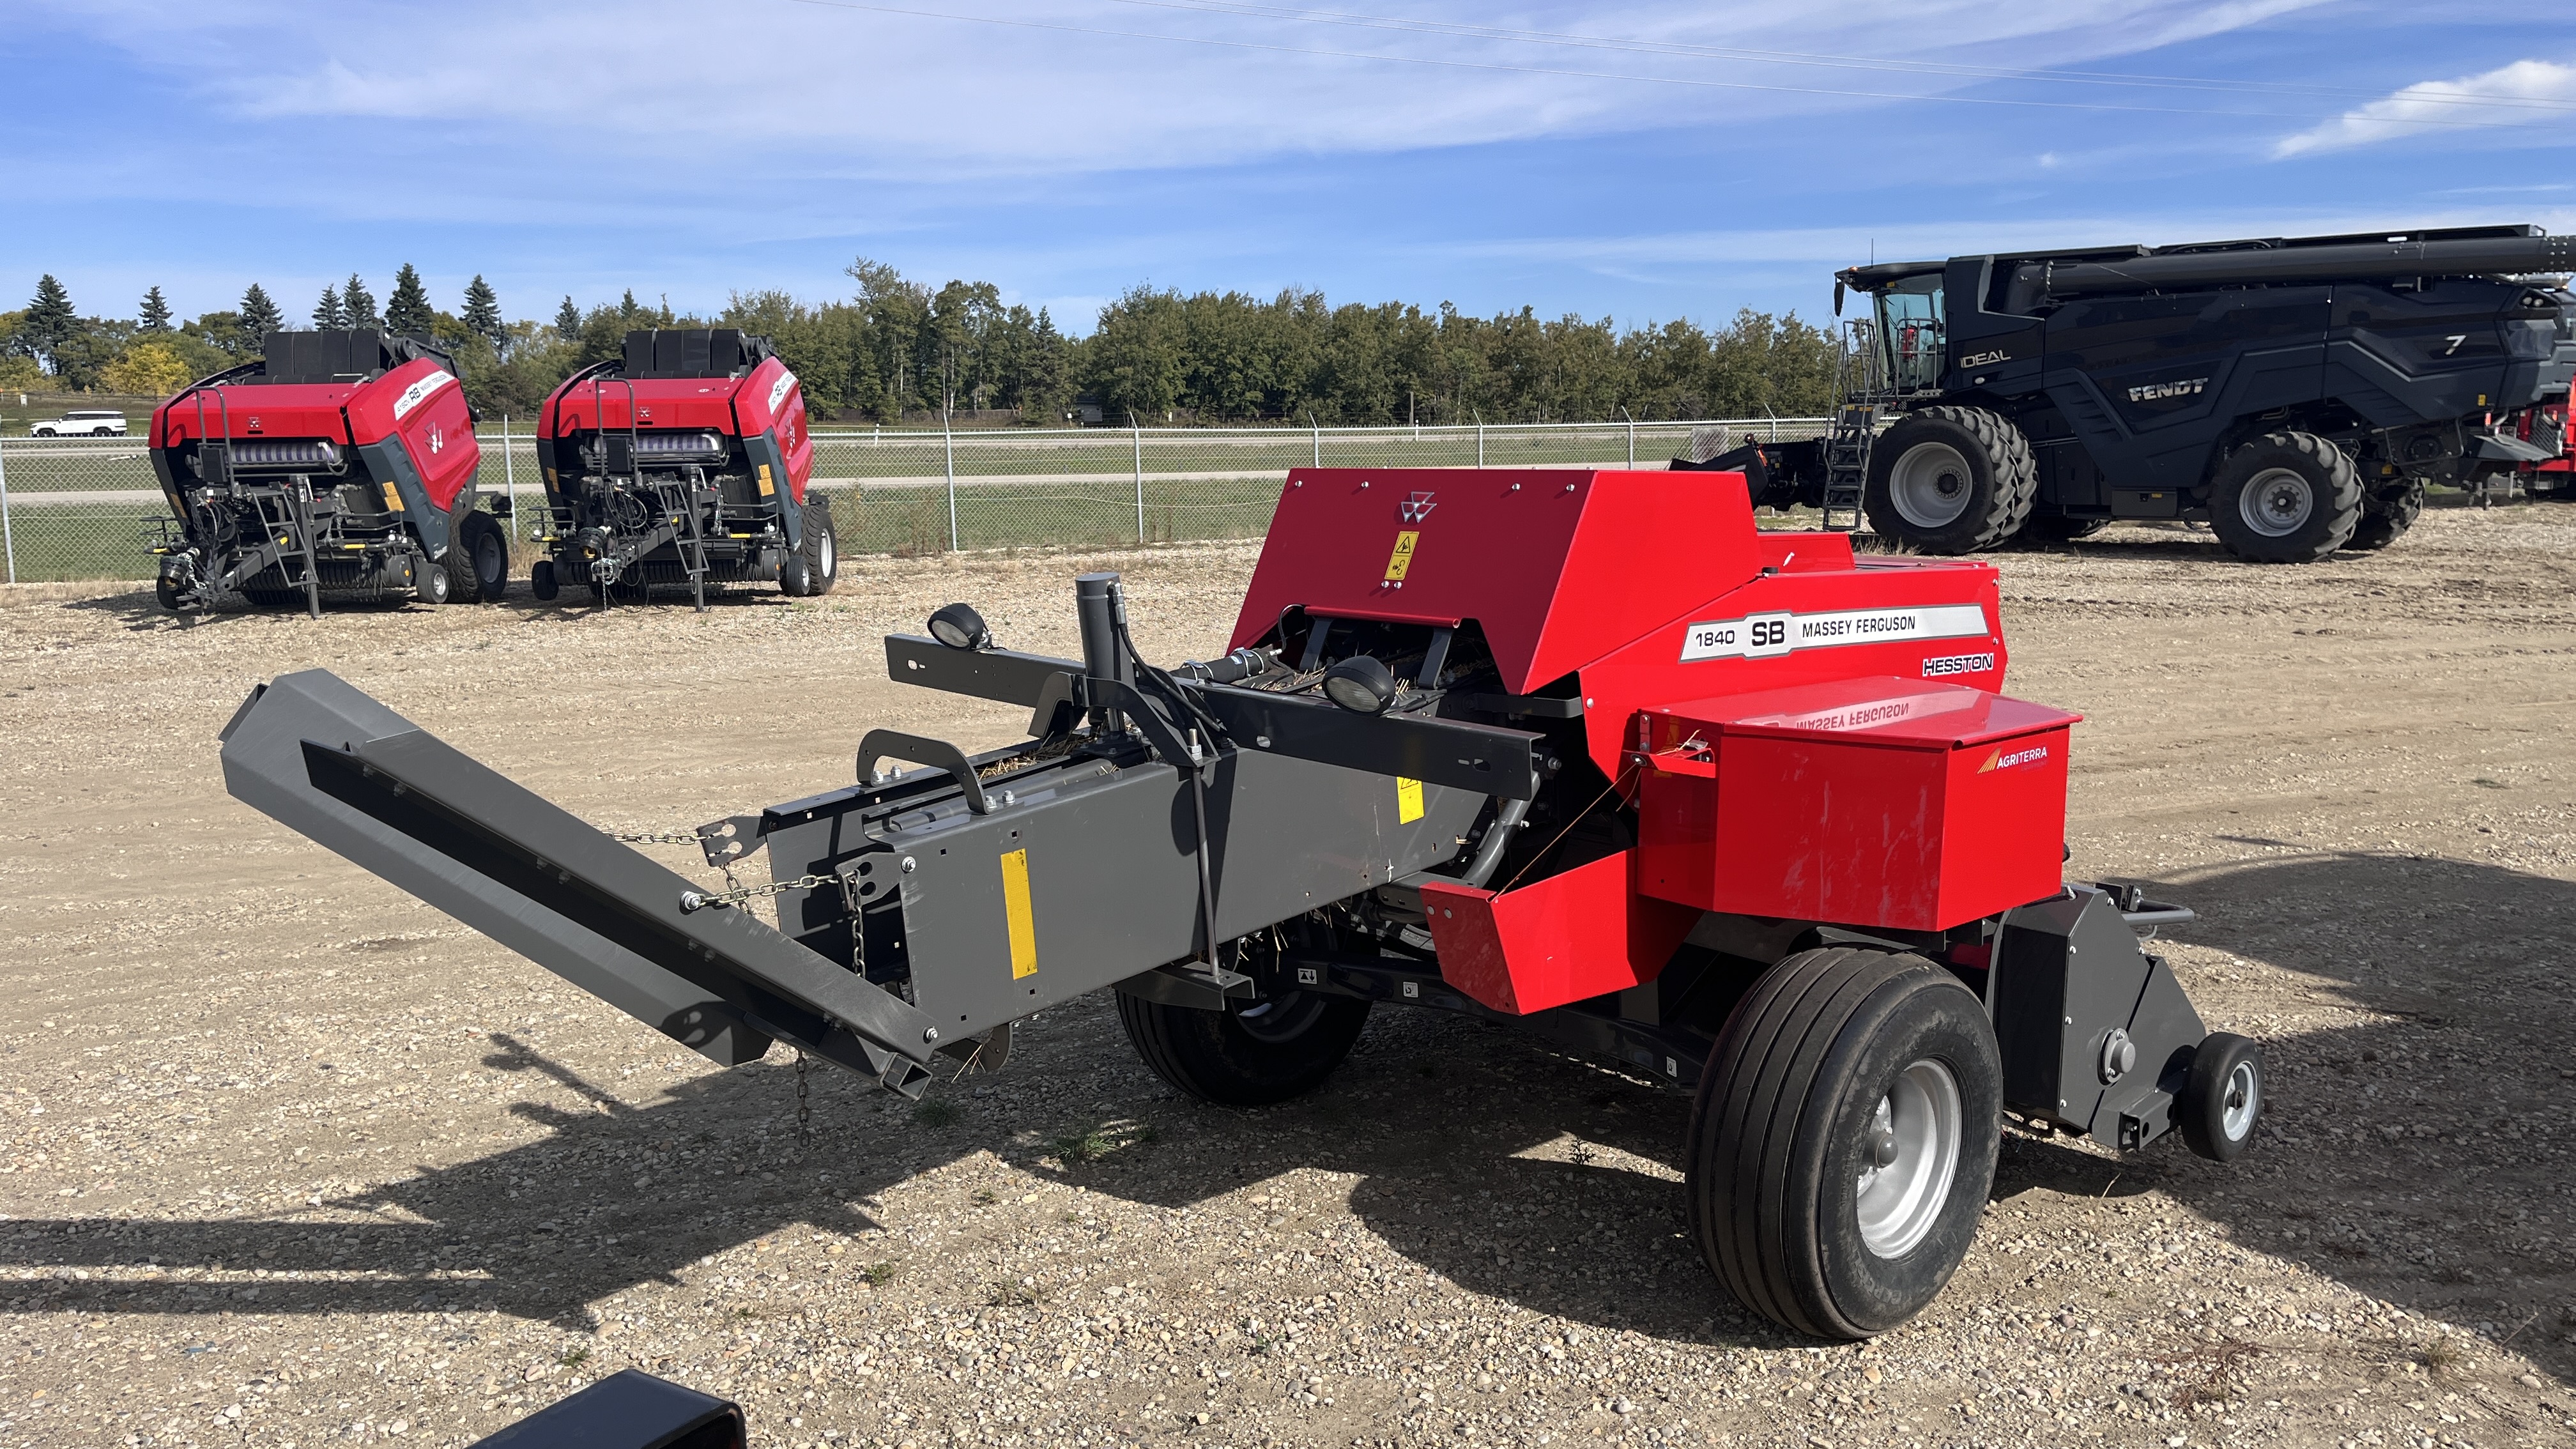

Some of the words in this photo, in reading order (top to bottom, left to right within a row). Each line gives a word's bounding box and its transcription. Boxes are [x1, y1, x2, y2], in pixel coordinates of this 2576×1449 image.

[2444, 335, 2466, 356] 7
[1959, 349, 2011, 369] IDEAL
[409, 387, 421, 402] RB
[2128, 378, 2209, 402] FENDT
[1696, 629, 1735, 647] 1840
[1751, 620, 1785, 647] SB
[1802, 620, 1852, 638] MASSEY
[1856, 616, 1915, 634] FERGUSON
[1923, 655, 1993, 675] HESSTON
[1997, 746, 2048, 770] AGRITERRA
